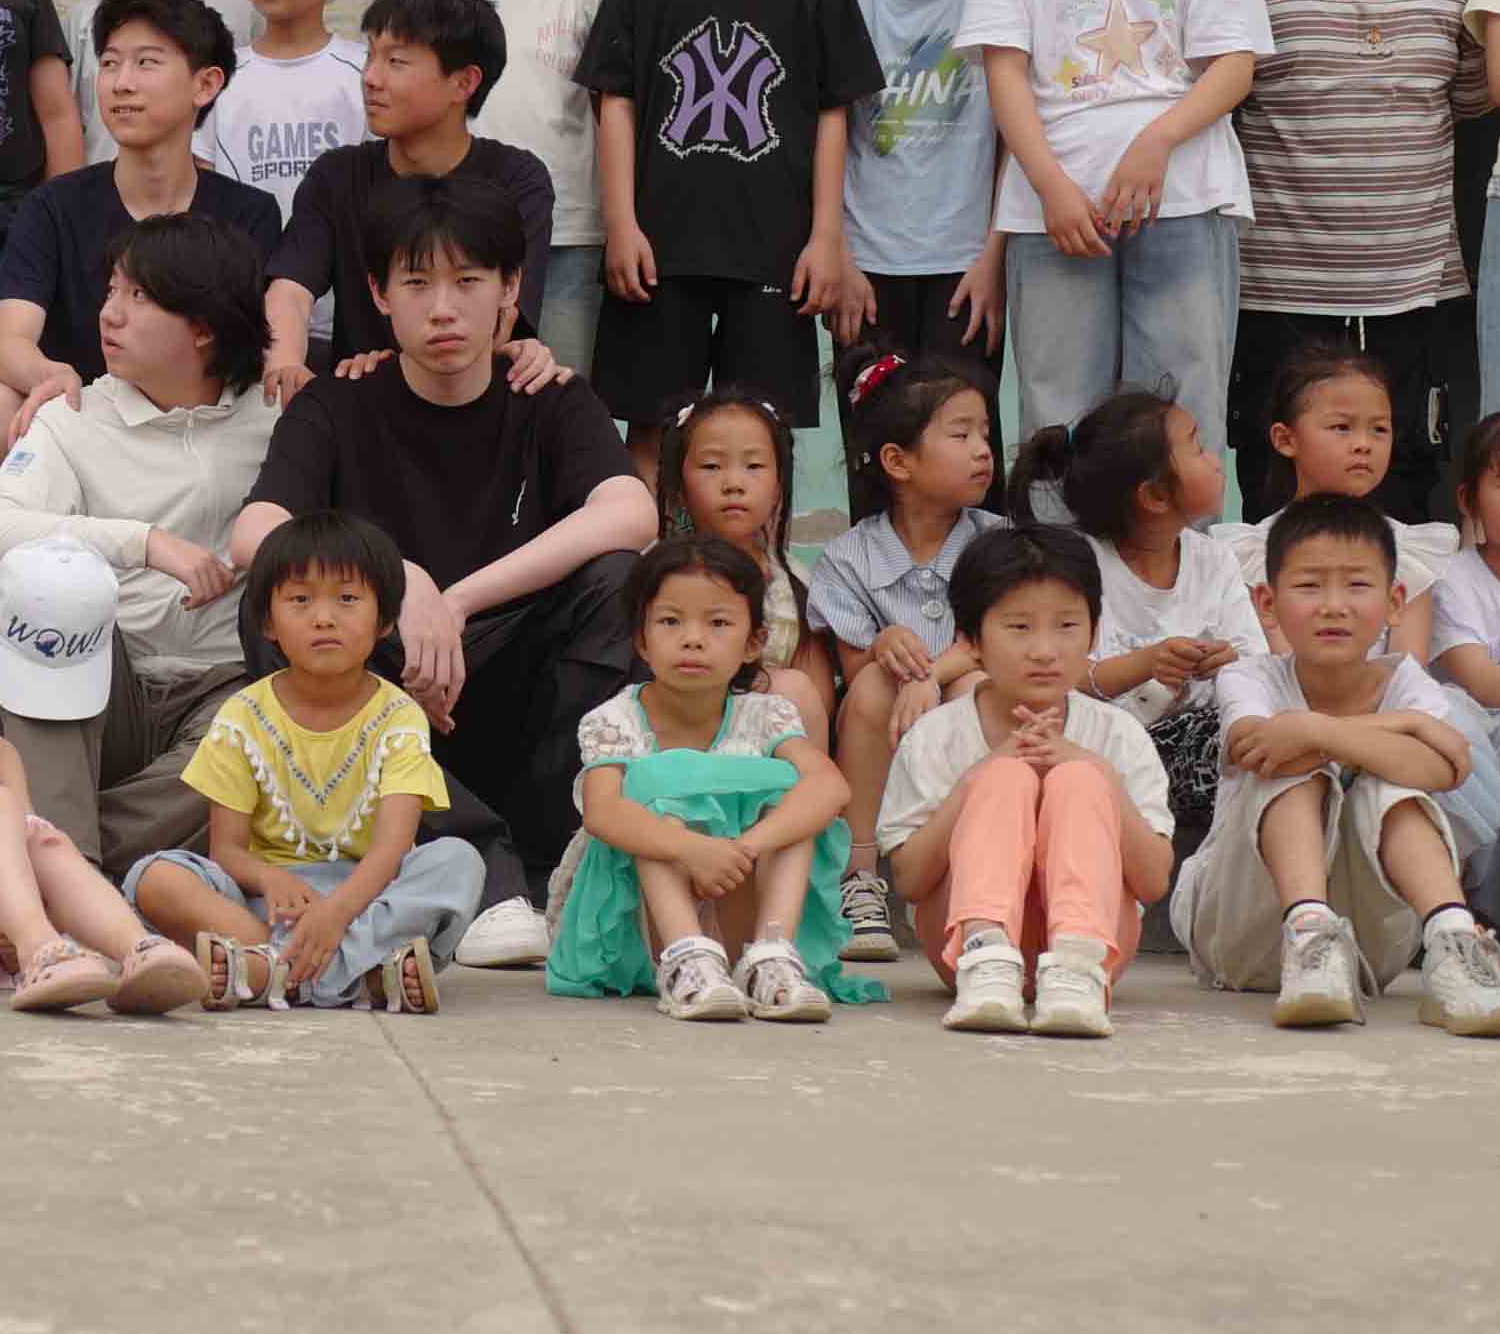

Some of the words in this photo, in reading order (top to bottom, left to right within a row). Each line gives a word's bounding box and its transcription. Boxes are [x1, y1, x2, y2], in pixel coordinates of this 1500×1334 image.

[880, 69, 977, 107] HINA
[248, 122, 340, 164] GAMES
[251, 160, 313, 182] SPOR
[8, 615, 104, 658] WOW!
